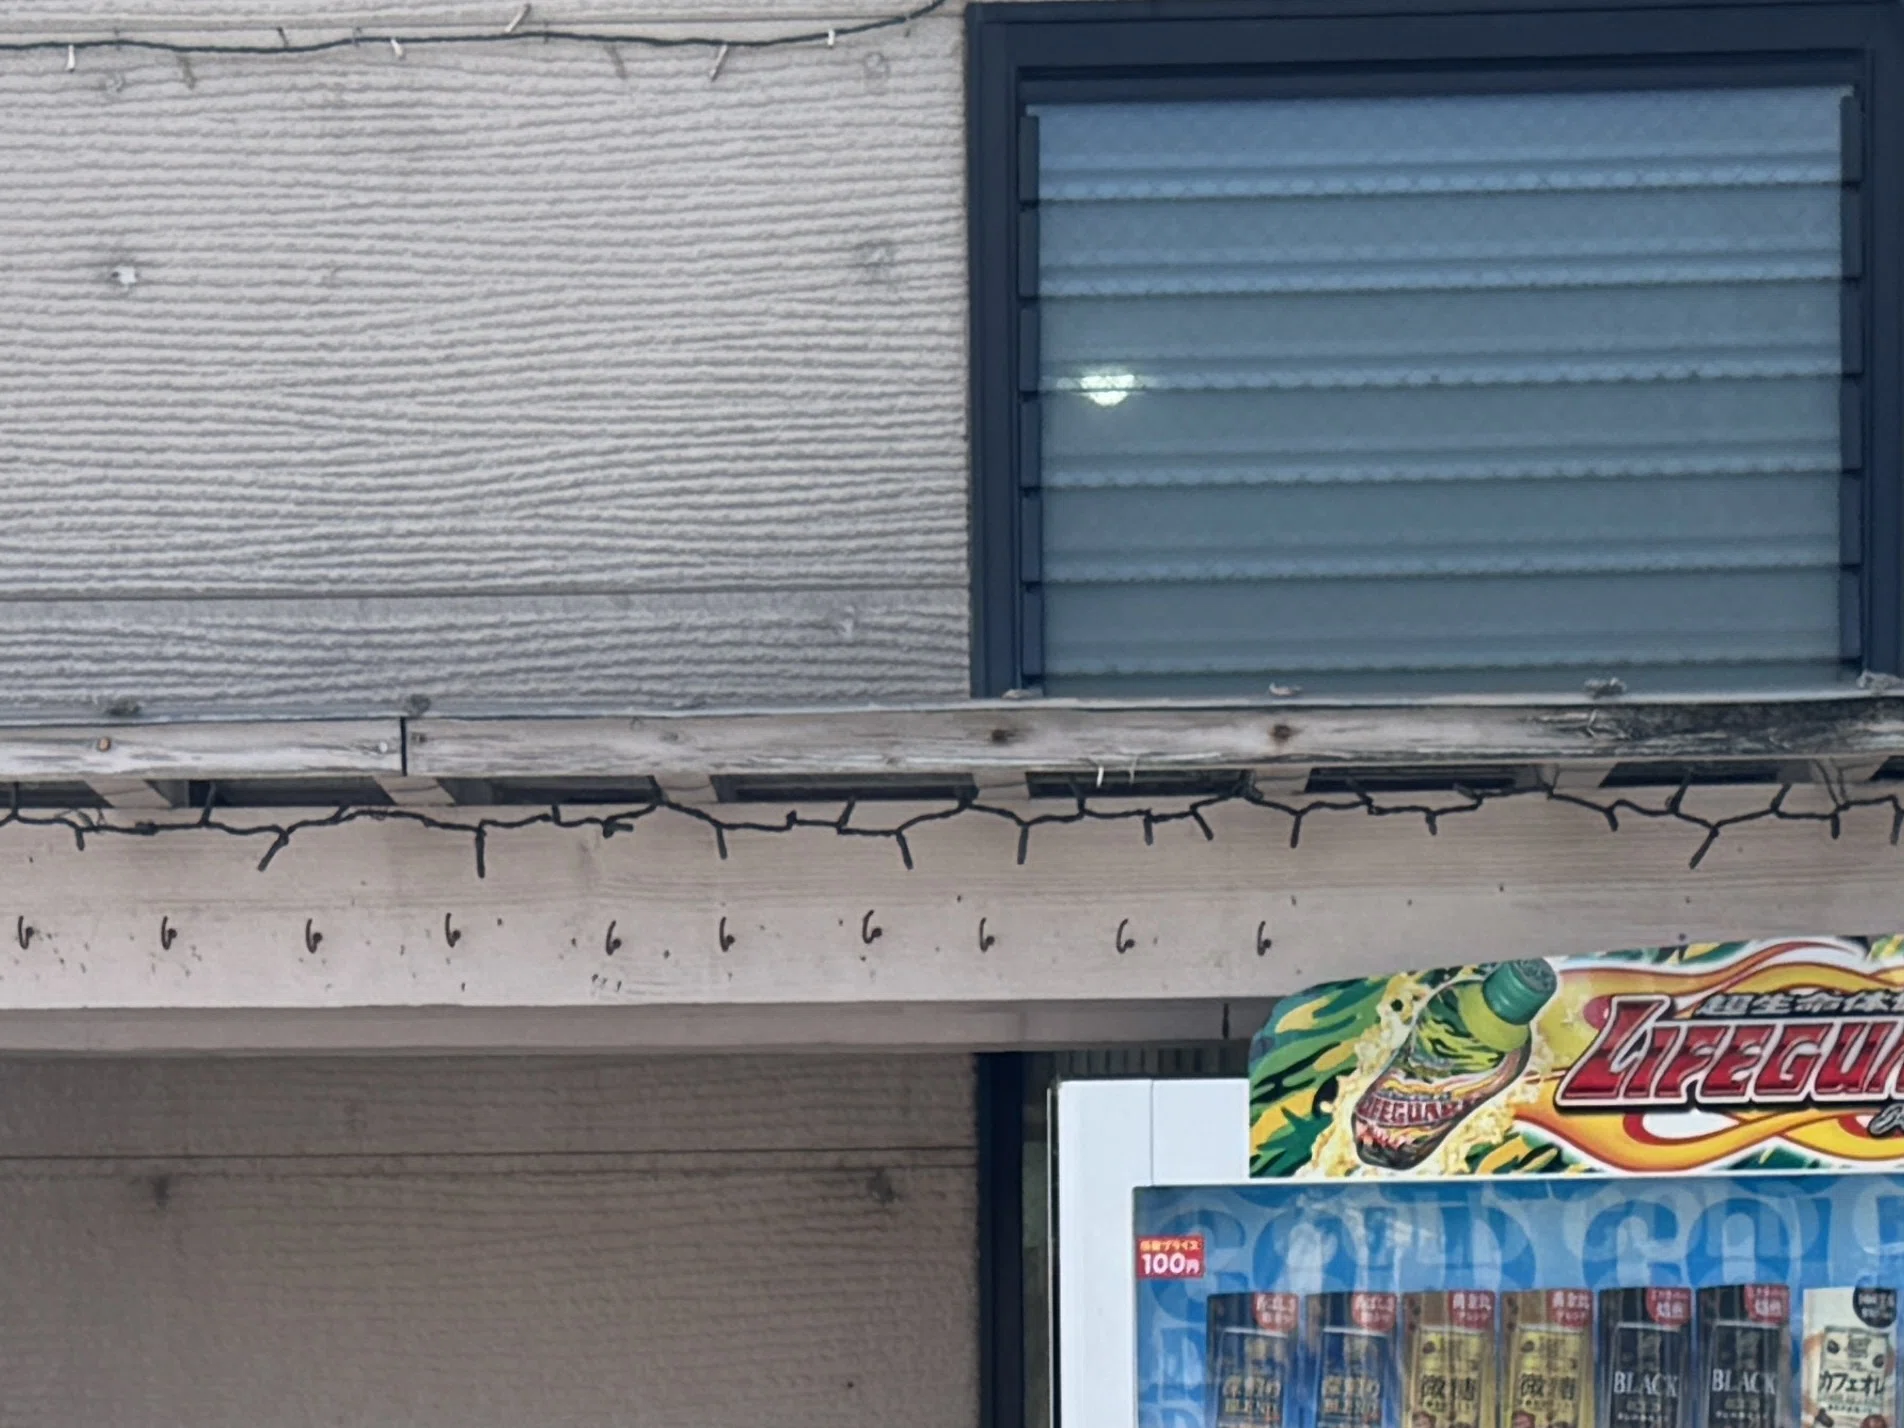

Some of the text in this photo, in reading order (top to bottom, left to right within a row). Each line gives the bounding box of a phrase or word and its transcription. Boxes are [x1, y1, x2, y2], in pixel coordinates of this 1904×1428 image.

[1141, 1253, 1200, 1274] 100円
[1613, 1371, 1679, 1397] BLACK
[1712, 1368, 1777, 1395] BLACK
[1819, 1372, 1886, 1396] カフェオレ
